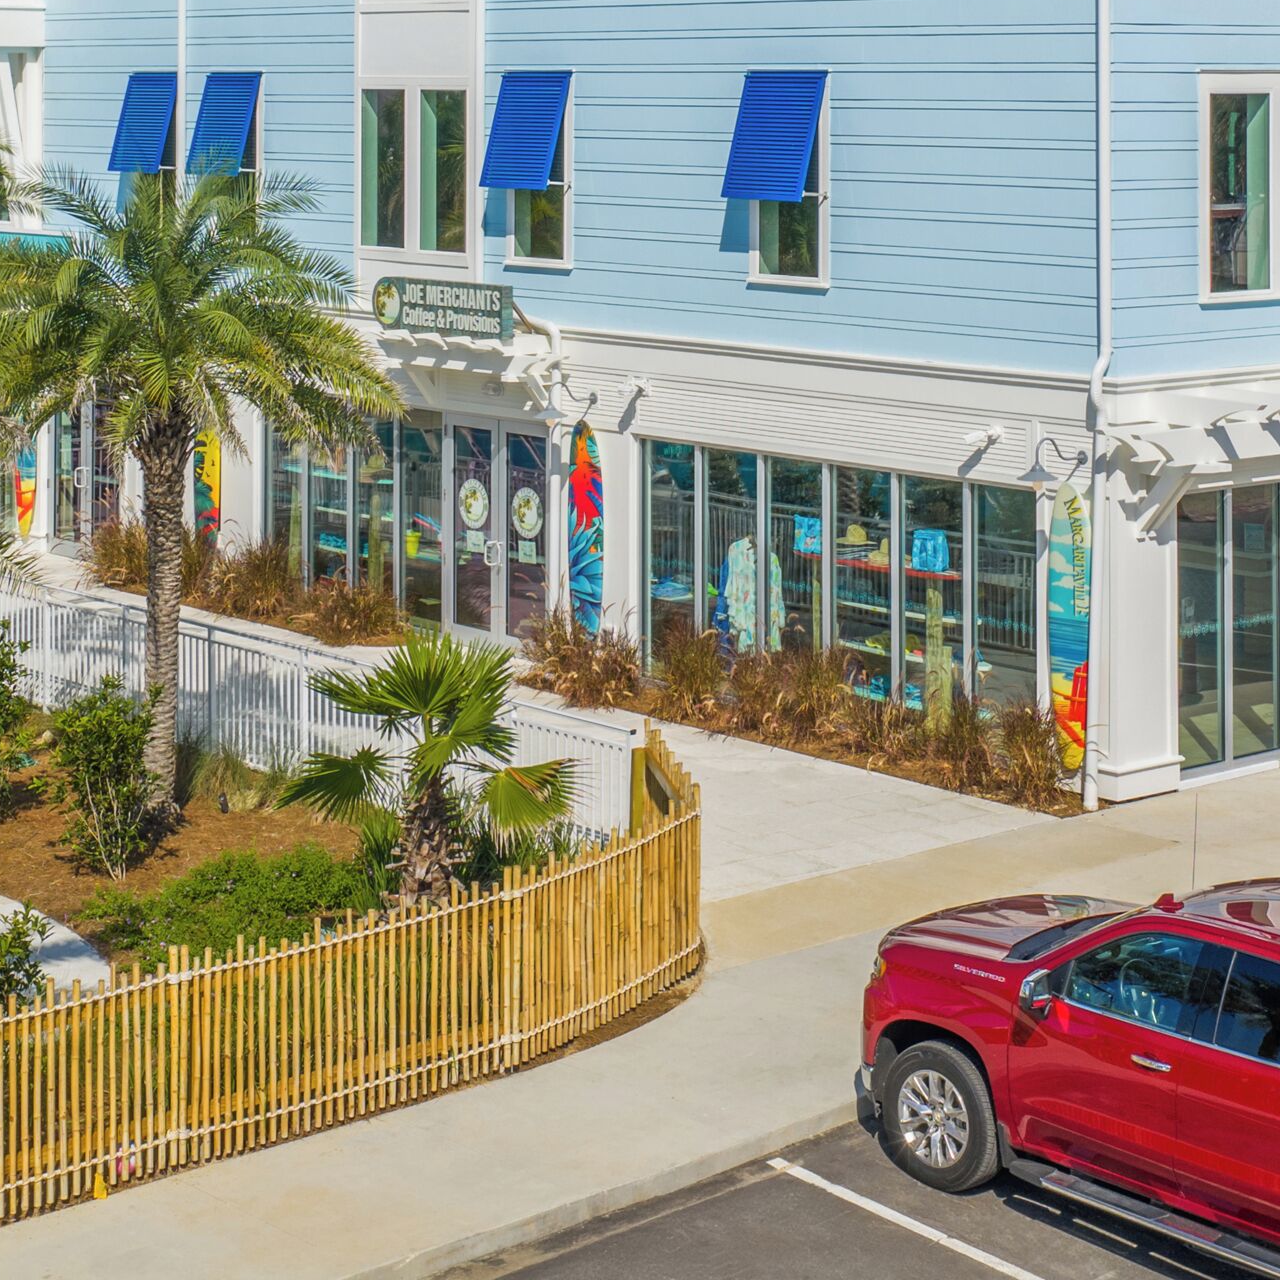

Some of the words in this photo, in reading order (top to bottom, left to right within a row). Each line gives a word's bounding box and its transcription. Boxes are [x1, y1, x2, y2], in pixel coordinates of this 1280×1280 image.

[402, 283, 424, 305] JOE
[426, 285, 501, 312] MERCHANTS
[402, 306, 435, 327] Coffee
[436, 310, 445, 329] &
[446, 312, 501, 334] Provisions
